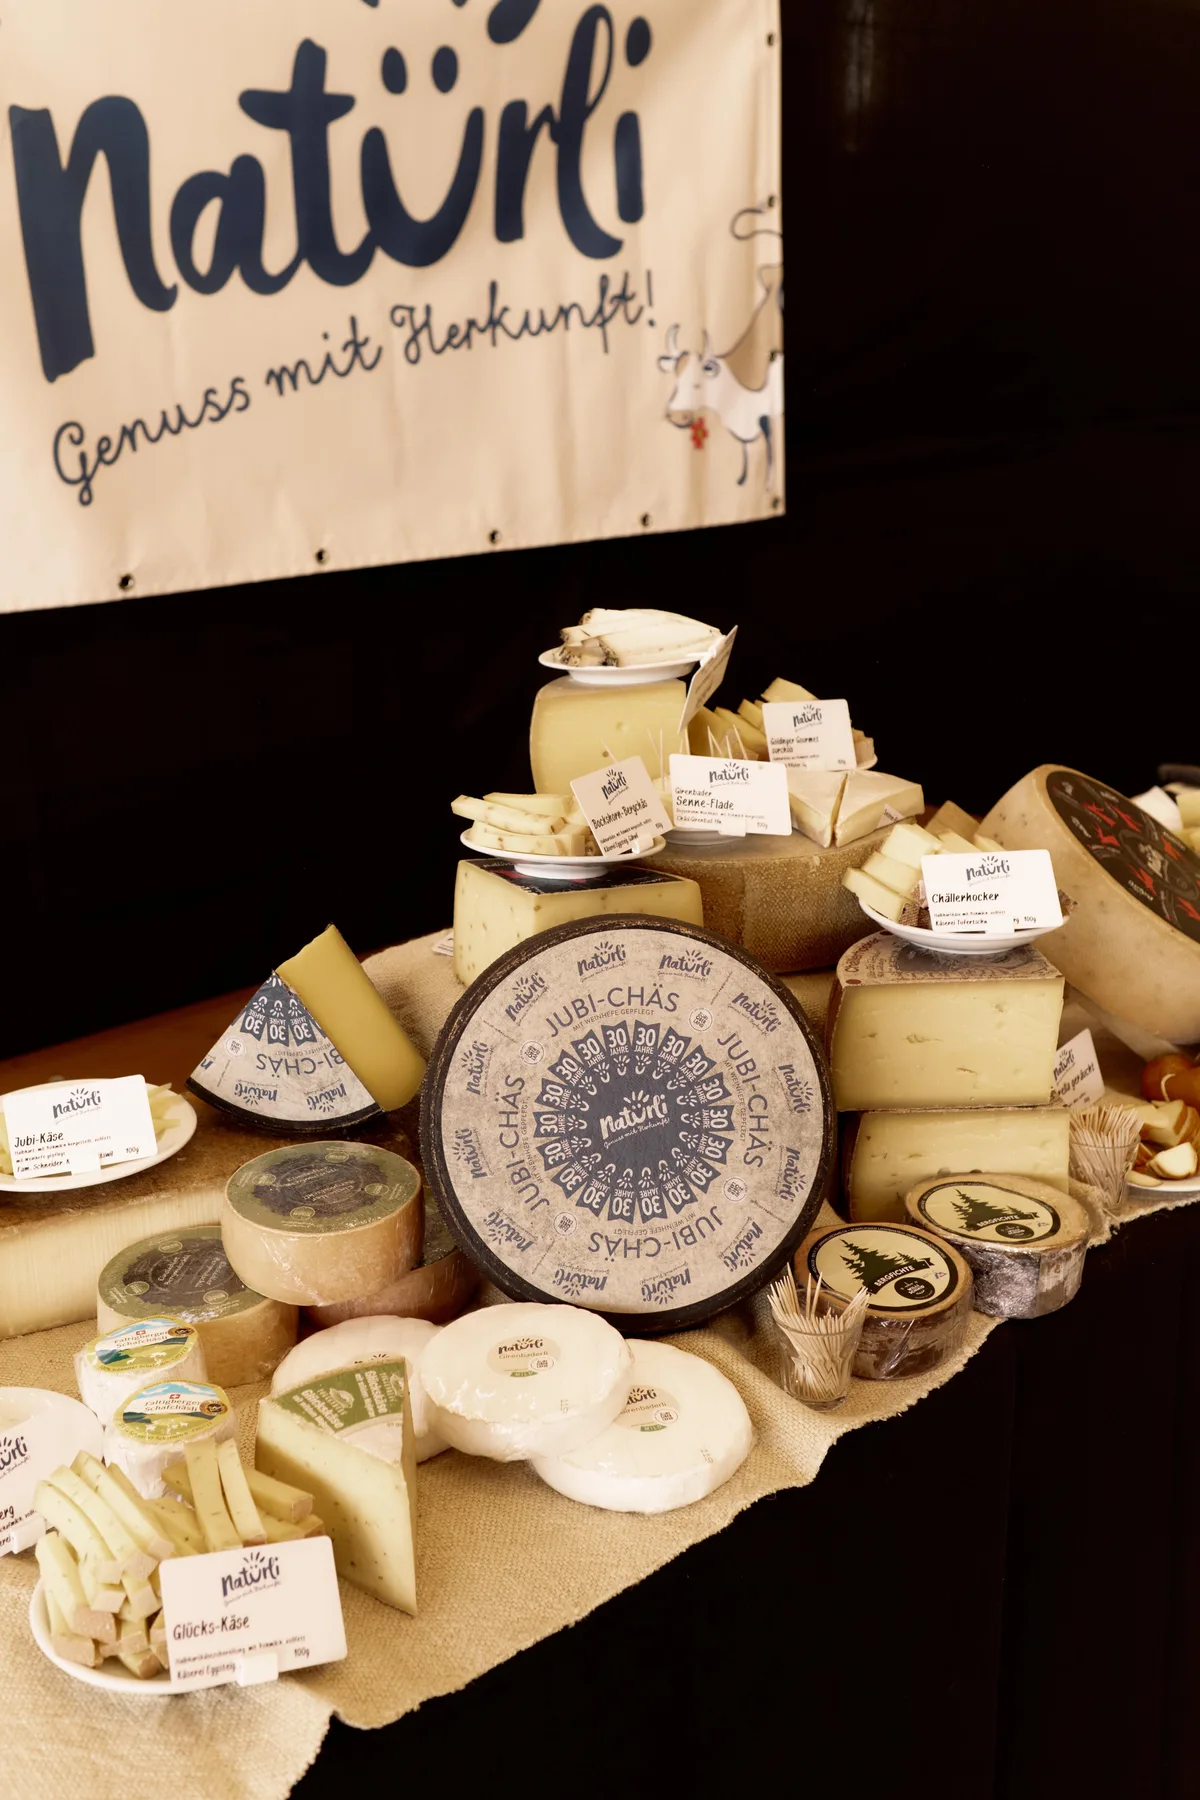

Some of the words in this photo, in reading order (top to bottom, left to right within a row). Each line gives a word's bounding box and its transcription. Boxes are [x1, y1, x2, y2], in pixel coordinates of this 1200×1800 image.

[52, 375, 251, 506] Genuss
[265, 314, 383, 397] mit
[390, 268, 659, 364] Herkunft!
[676, 795, 735, 811] Senne-Flade
[931, 891, 999, 904] Chällerhocker
[249, 1008, 265, 1021] JAHRE
[290, 1015, 307, 1026] JAHRE
[545, 983, 680, 1038] JUBI-CHÄS
[572, 1022, 585, 1032] MIT
[584, 1009, 619, 1025] WEINHEFE
[620, 1008, 655, 1016] GEPFLEGT
[245, 1015, 264, 1035] 30
[269, 1016, 287, 1026] JAHRE
[269, 1023, 287, 1041] 30
[293, 1022, 312, 1041] 30
[606, 1028, 627, 1048] 30
[636, 1027, 656, 1046] 30
[578, 1038, 600, 1060] 30
[610, 1045, 629, 1056] JAHRE
[634, 1045, 654, 1055] JAHRE
[663, 1035, 685, 1057] 30
[587, 1051, 606, 1068] JAHRE
[658, 1051, 678, 1065] JAHRE
[685, 1052, 708, 1076] 30
[555, 1057, 578, 1080] 30
[569, 1066, 586, 1086] JAHRE
[679, 1064, 697, 1082] JAHRE
[542, 1084, 564, 1106] 30
[559, 1088, 572, 1110] JAHRE
[694, 1085, 708, 1104] JAHRE
[702, 1078, 723, 1100] 30
[717, 1033, 773, 1168] JUBI-CHÄS
[540, 1114, 558, 1134] 30
[558, 1113, 566, 1134] JAHRE
[702, 1108, 711, 1129] JAHRE
[710, 1108, 729, 1129] 30
[14, 1131, 64, 1148] Jubi-Käse
[495, 1075, 550, 1211] JUBI-CHÄS
[560, 1139, 574, 1159] JAHRE
[697, 1133, 709, 1155] JAHRE
[704, 1137, 726, 1159] 30
[544, 1142, 566, 1165] 30
[571, 1160, 590, 1179] JAHRE
[682, 1156, 699, 1176] JAHRE
[690, 1162, 713, 1186] 30
[559, 1167, 582, 1191] 30
[590, 1178, 611, 1193] JAHRE
[663, 1174, 682, 1192] JAHRE
[583, 1186, 606, 1209] 30
[614, 1189, 635, 1199] JAHRE
[639, 1187, 659, 1199] JAHRE
[668, 1183, 691, 1206] 30
[612, 1197, 633, 1217] 30
[641, 1195, 663, 1216] 30
[976, 1214, 1020, 1227] BERGFICHTE
[587, 1205, 723, 1262] JUBI-CHÄS
[873, 1264, 916, 1288] BERGFICHTE
[173, 1615, 250, 1641] Glücks-Käse
[294, 1647, 311, 1659] 100g
[177, 1667, 205, 1680] Käserei
